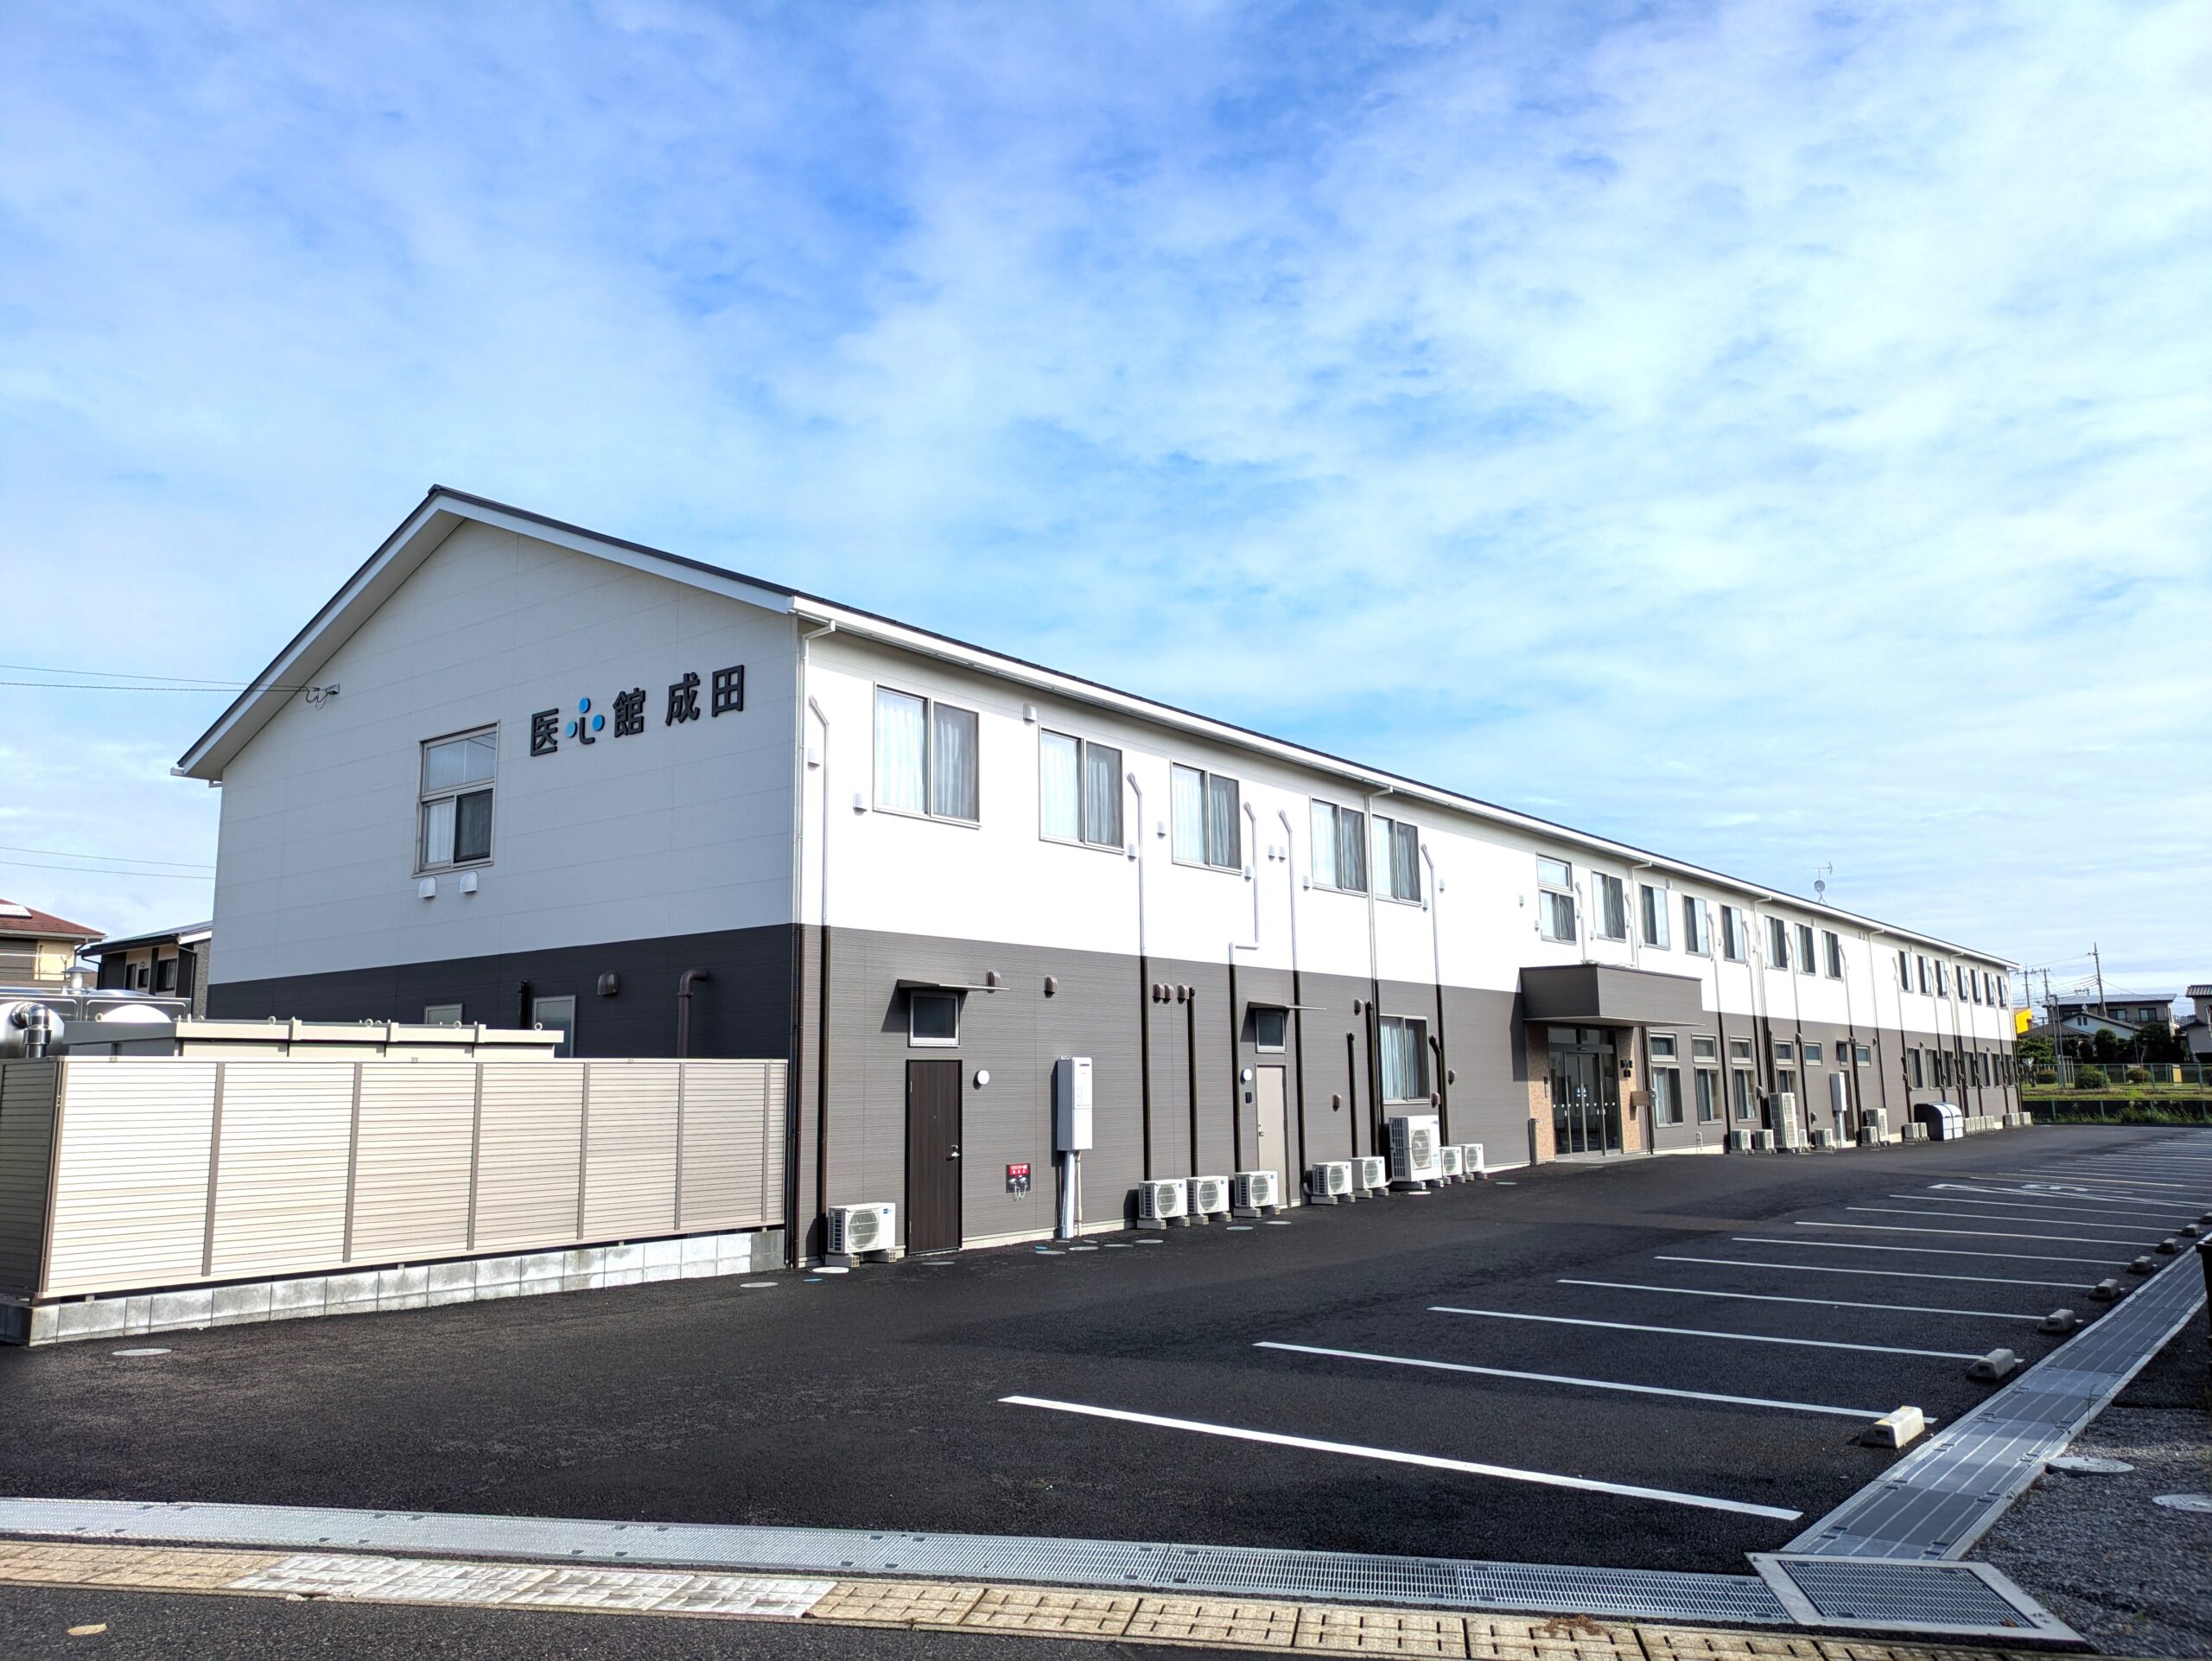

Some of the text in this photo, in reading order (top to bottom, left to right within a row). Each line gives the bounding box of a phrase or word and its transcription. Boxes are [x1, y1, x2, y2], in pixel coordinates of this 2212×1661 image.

[530, 665, 745, 756] 医心館 成田
